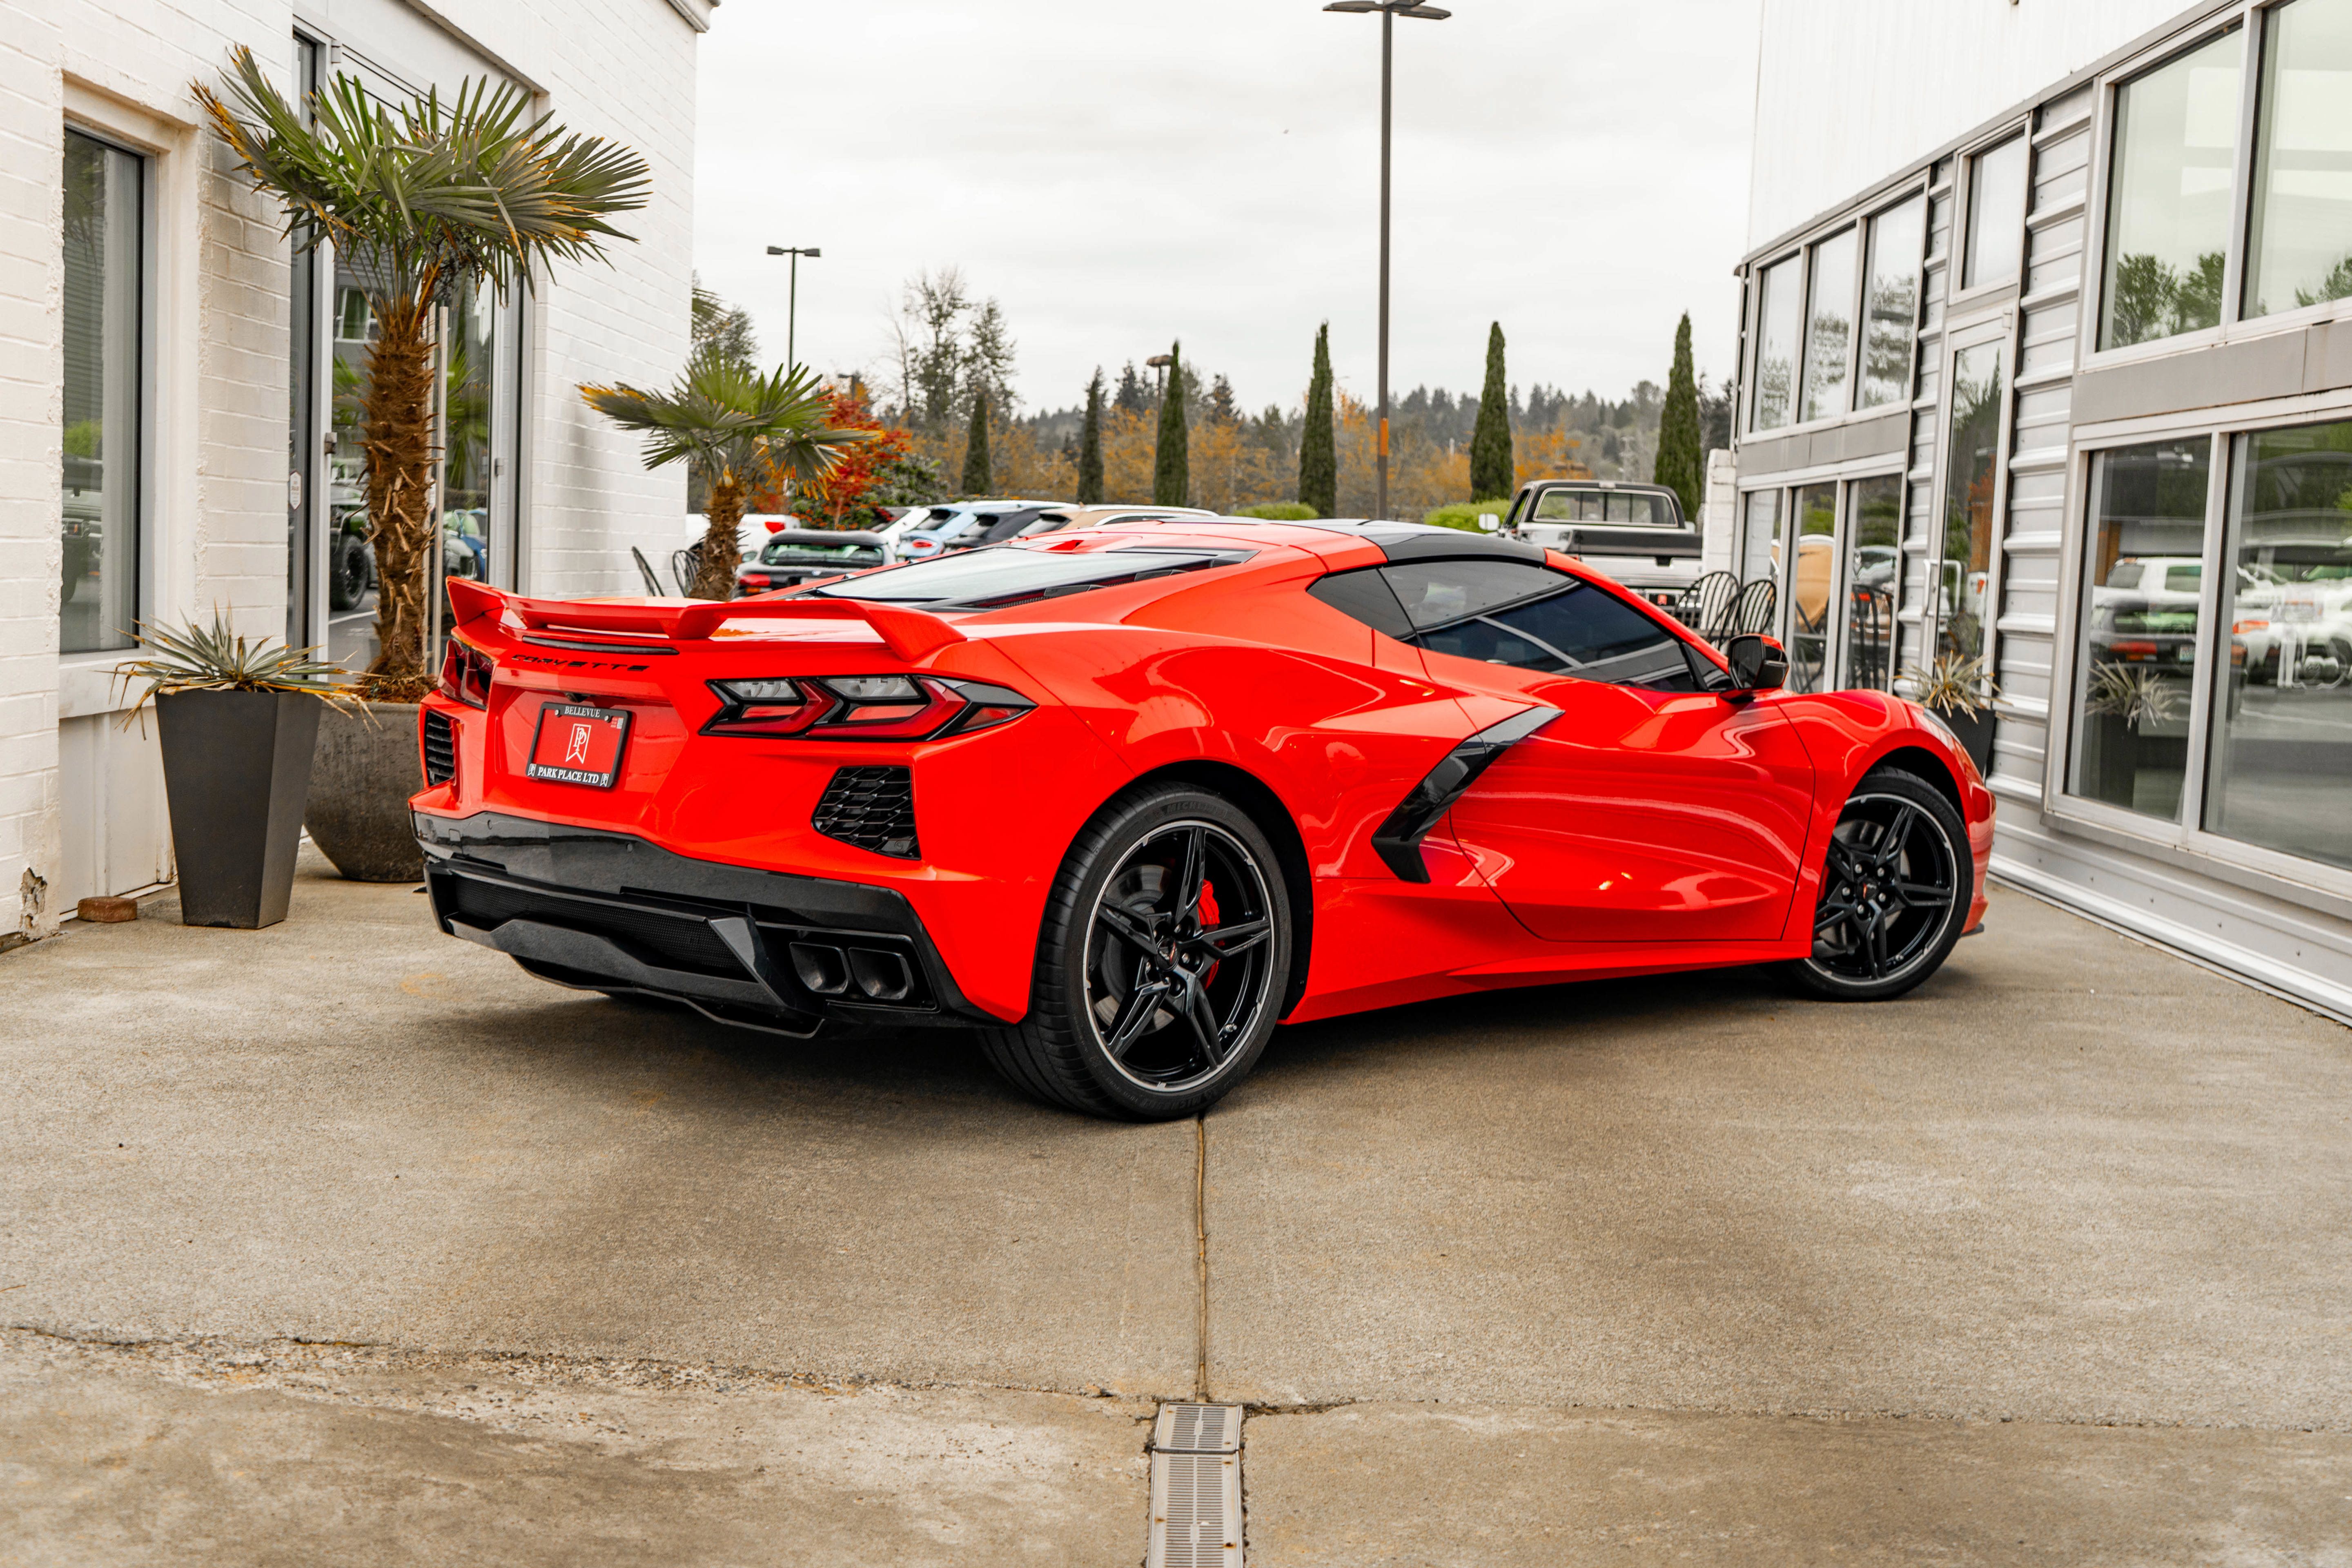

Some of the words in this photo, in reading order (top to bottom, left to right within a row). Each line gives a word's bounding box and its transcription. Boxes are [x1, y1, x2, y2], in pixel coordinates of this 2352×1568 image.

[512, 654, 650, 670] CORVETTE
[564, 706, 601, 717] BELLEVUE
[537, 766, 558, 778] PARK
[557, 770, 582, 782] PLACE
[582, 773, 599, 784] LTD
